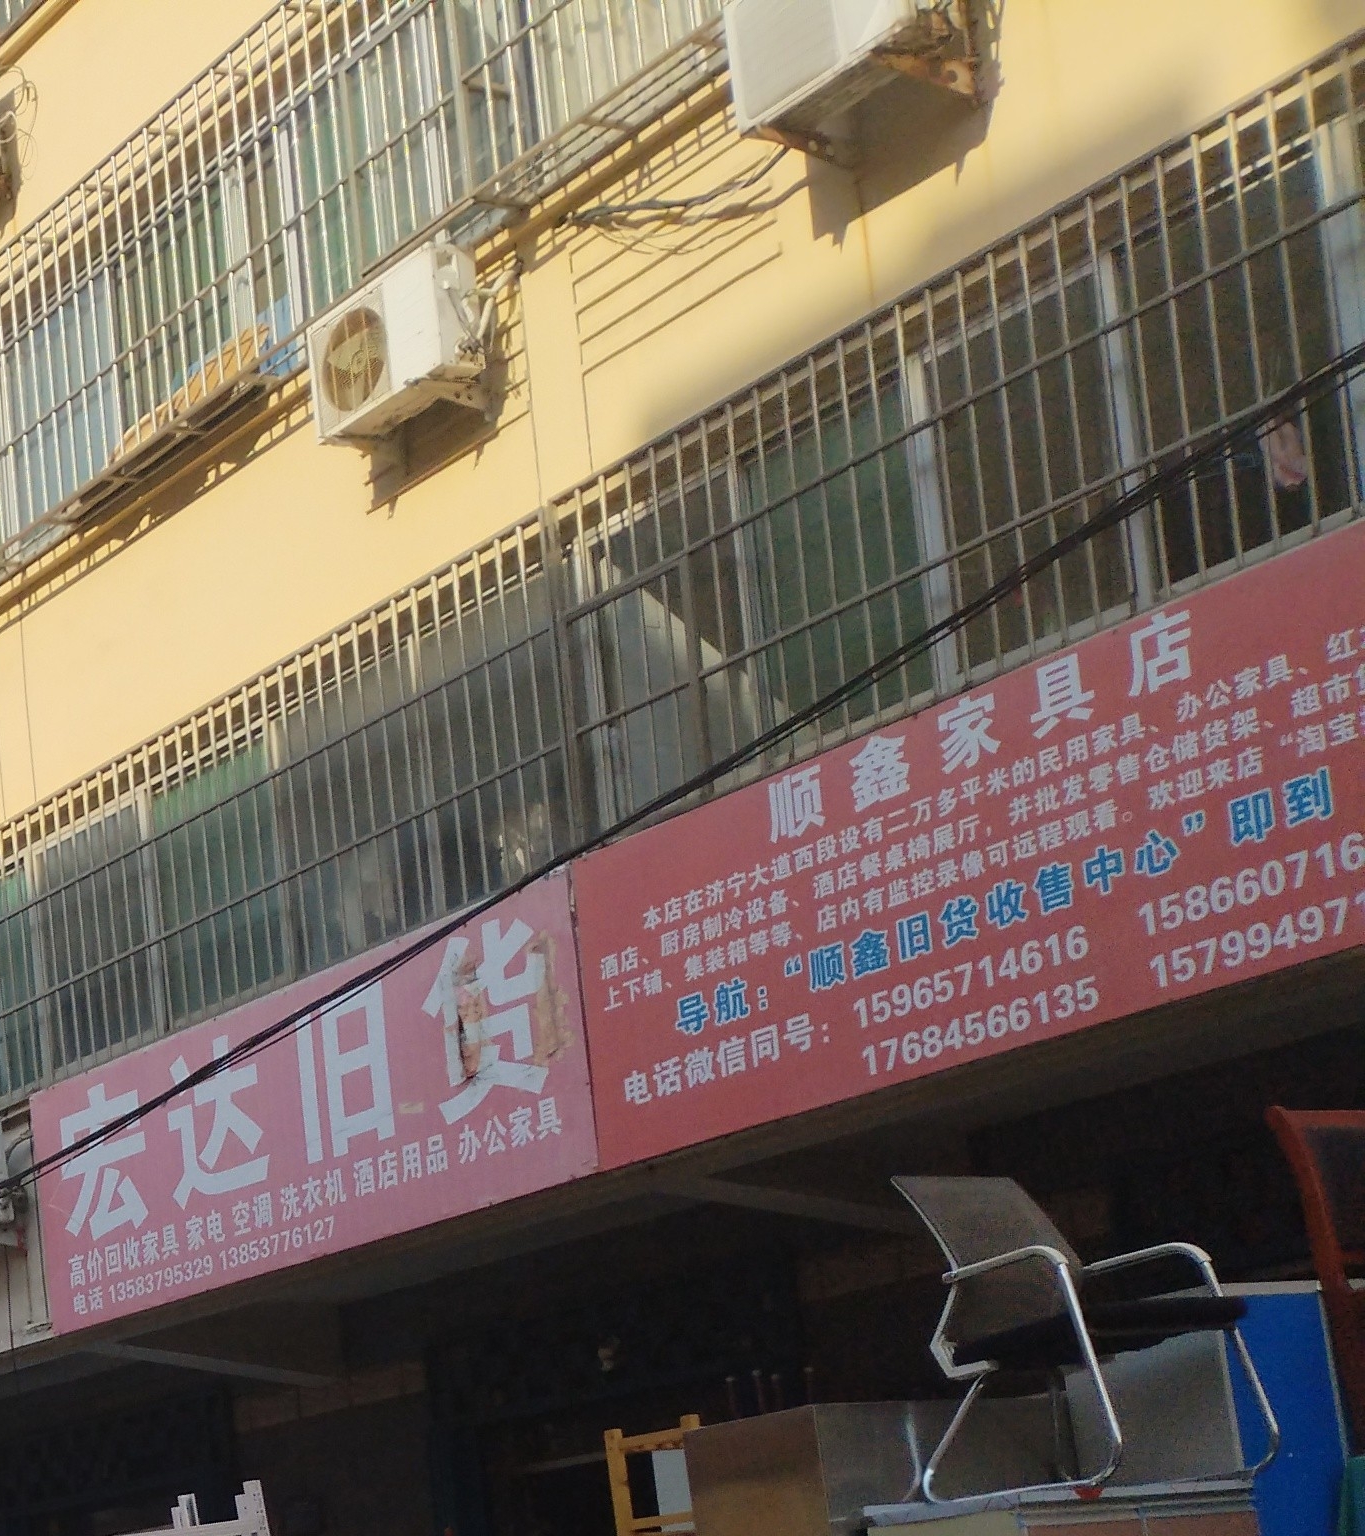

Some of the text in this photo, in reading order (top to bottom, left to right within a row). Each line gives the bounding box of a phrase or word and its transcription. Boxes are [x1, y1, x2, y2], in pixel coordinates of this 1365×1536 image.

[642, 626, 1365, 930] 本店在济宁大道西段设有二万多平米的民用家具、办公家具、红
[768, 608, 1193, 843] 顺鑫家具店
[853, 924, 1090, 1029] 15965714616
[1137, 831, 1365, 937] 158660716
[861, 975, 1100, 1076] 17684566135
[57, 917, 551, 1239] 宏达旧货
[67, 1096, 563, 1289] 高价回收家具 家电 空调 洗衣机 酒店用品 办公家具
[72, 1215, 336, 1317] 电话 13583795329 13853776127
